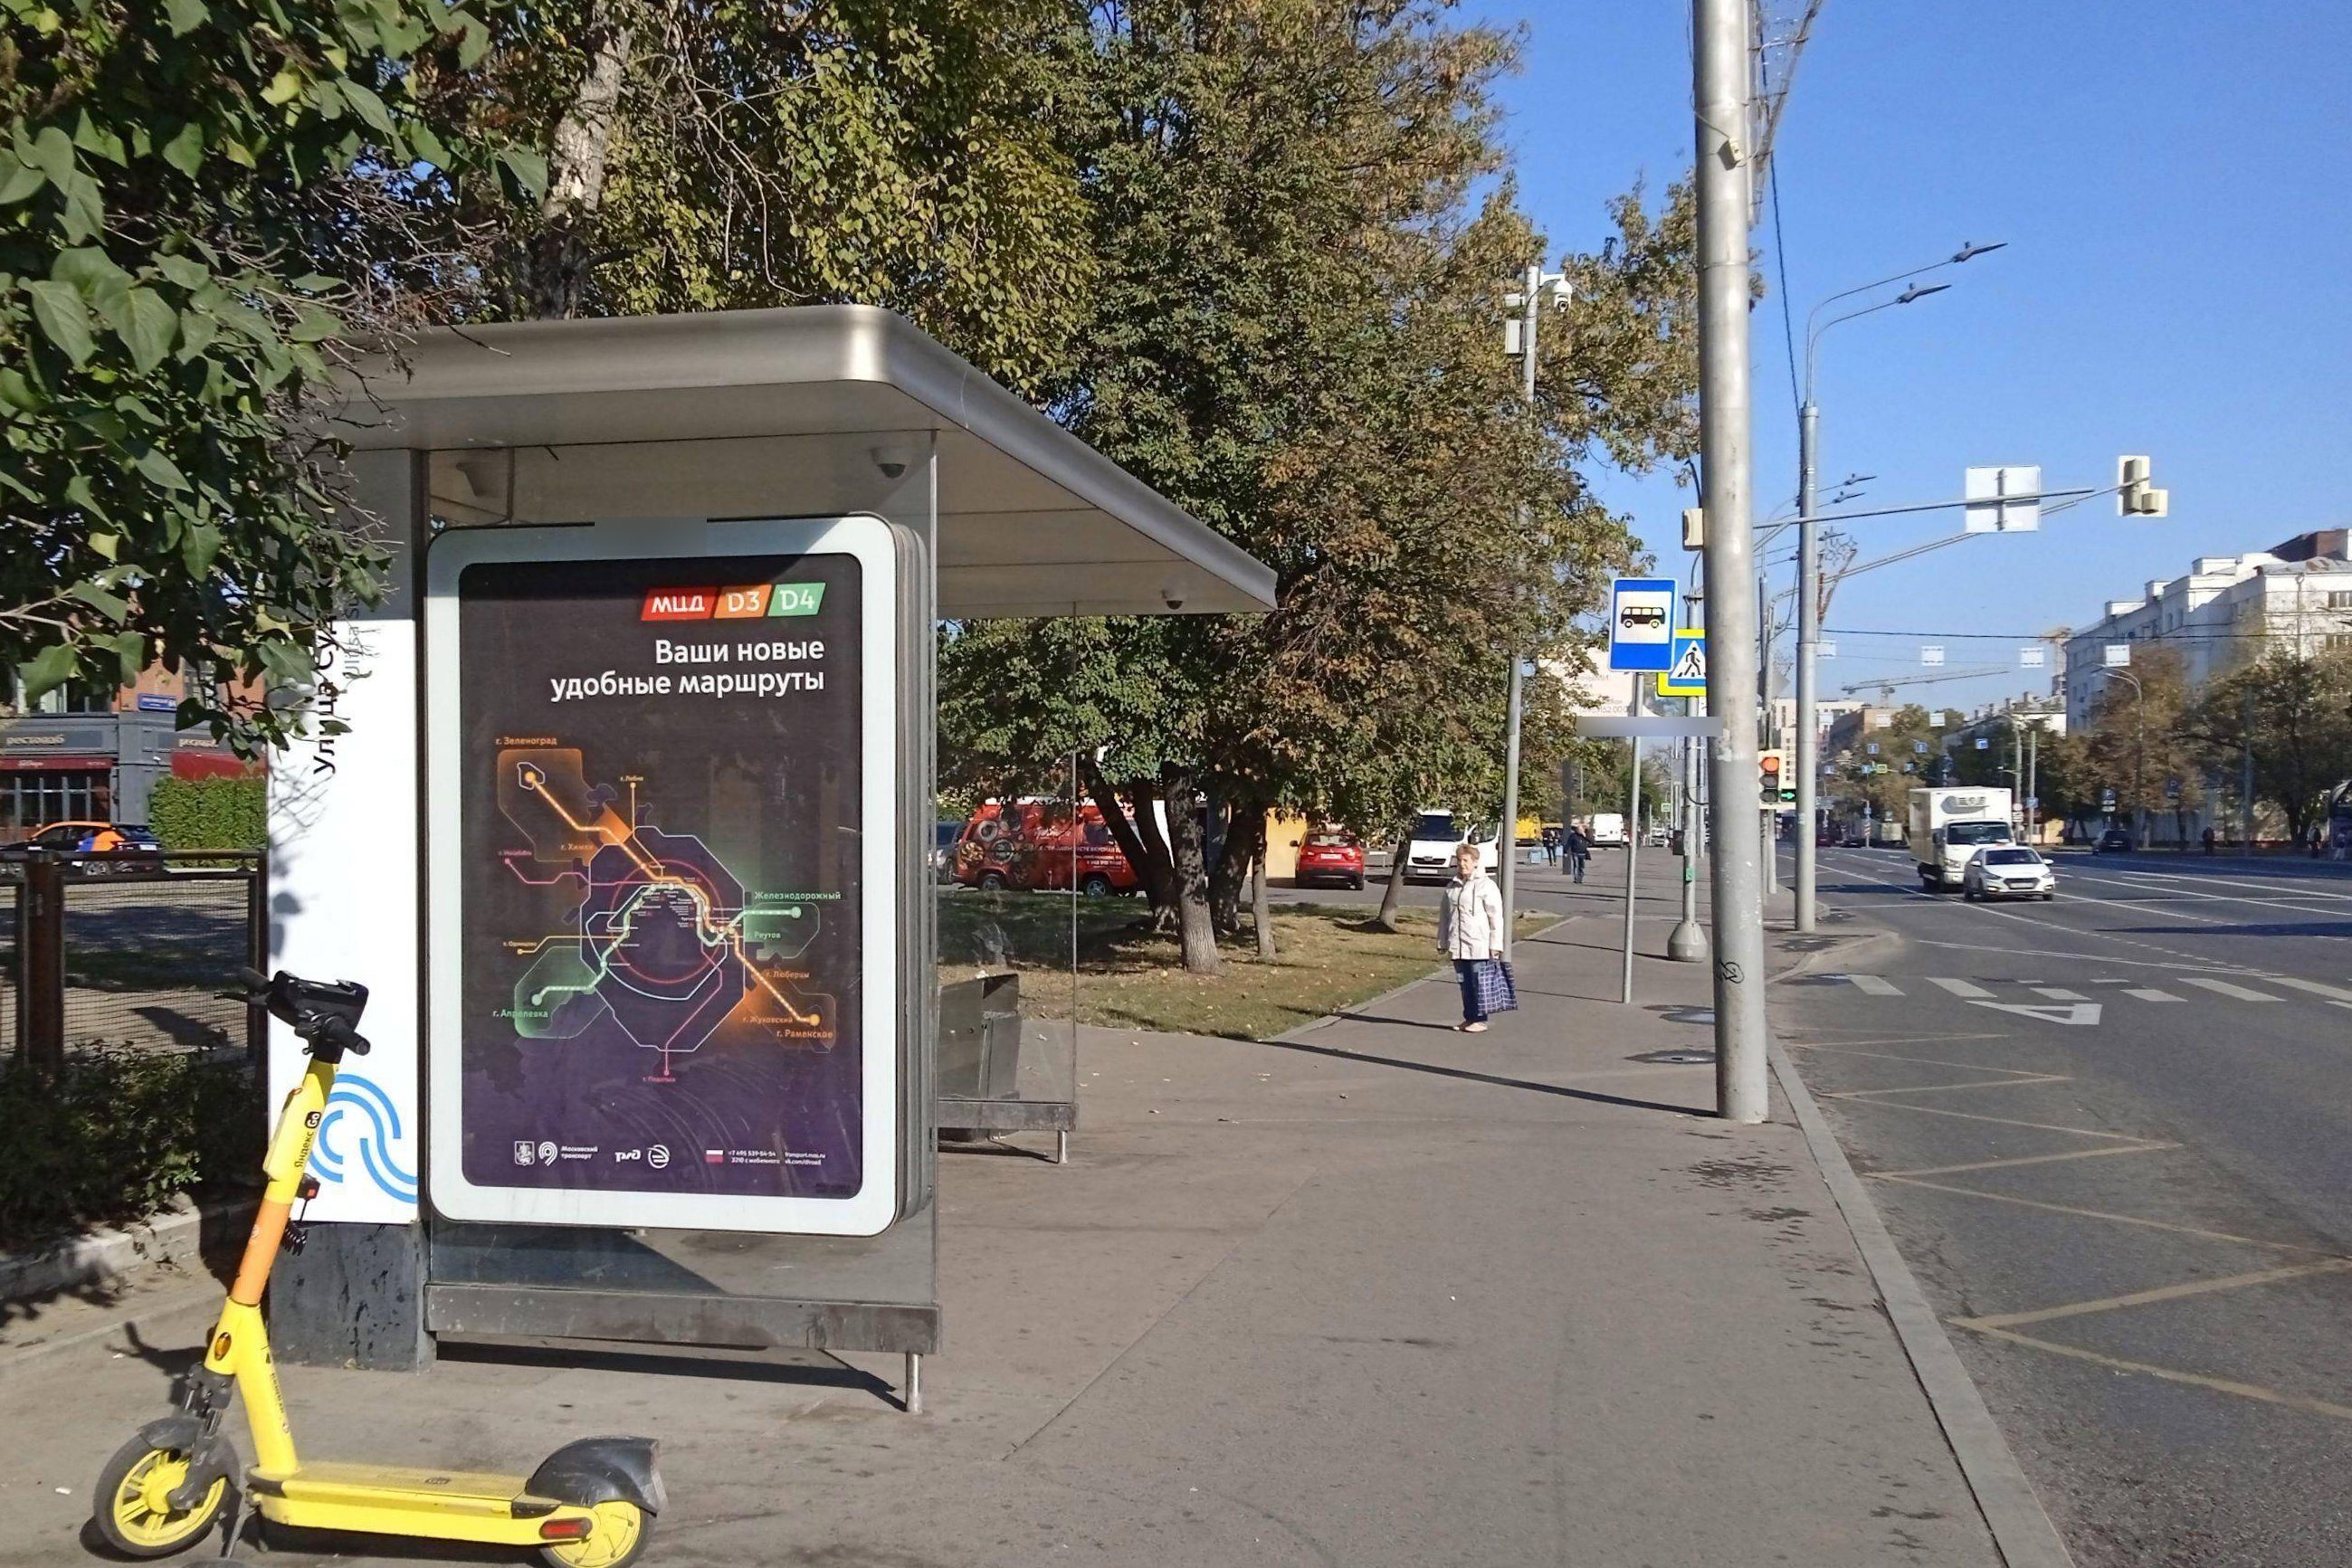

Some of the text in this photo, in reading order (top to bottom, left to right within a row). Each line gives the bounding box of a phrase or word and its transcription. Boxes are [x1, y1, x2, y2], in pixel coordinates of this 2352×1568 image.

[651, 589, 815, 614] МЦД D3 D4
[655, 640, 825, 664] Ваши новые
[550, 670, 824, 703] удобные маршруты
[503, 736, 558, 746] Зеленоград
[754, 891, 842, 901] Железнодорожный
[754, 931, 781, 939] Реутов
[773, 970, 810, 980] Люберцы
[500, 1009, 549, 1018] Апрелевка
[749, 1015, 794, 1024] Жуковский
[784, 1029, 833, 1039] Раменское
[294, 1112, 321, 1168] Яндекс Go
